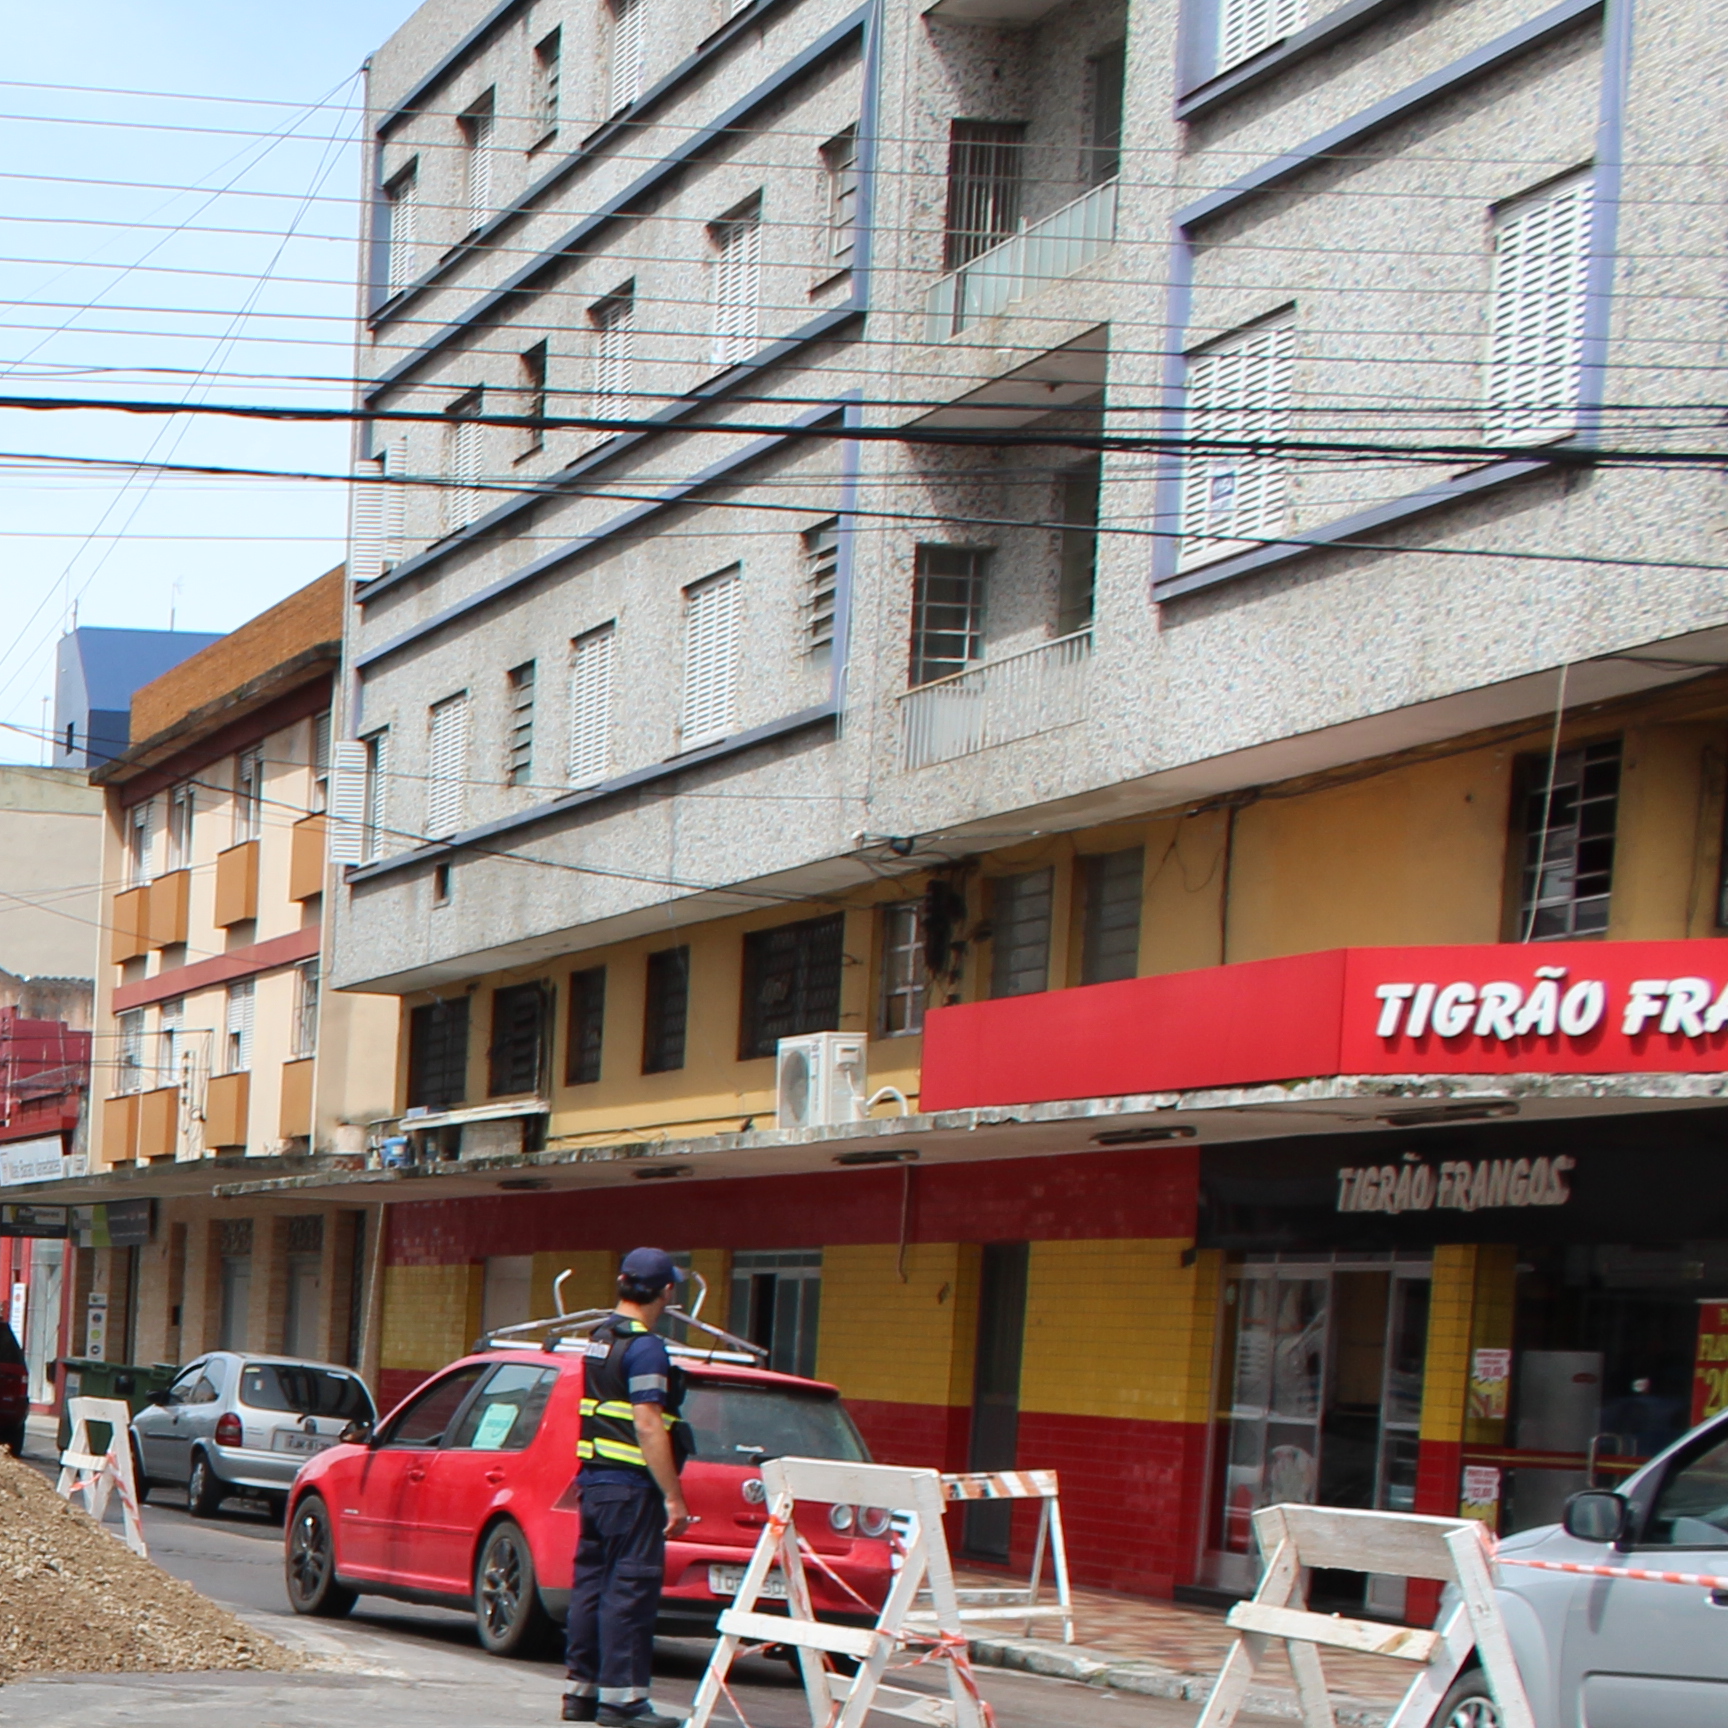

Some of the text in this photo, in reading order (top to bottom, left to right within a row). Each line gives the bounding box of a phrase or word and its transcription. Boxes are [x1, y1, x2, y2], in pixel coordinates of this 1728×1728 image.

[1375, 965, 1606, 1041] TIGRÃO
[1337, 1152, 1577, 1214] TIGRÃO FRANGOS
